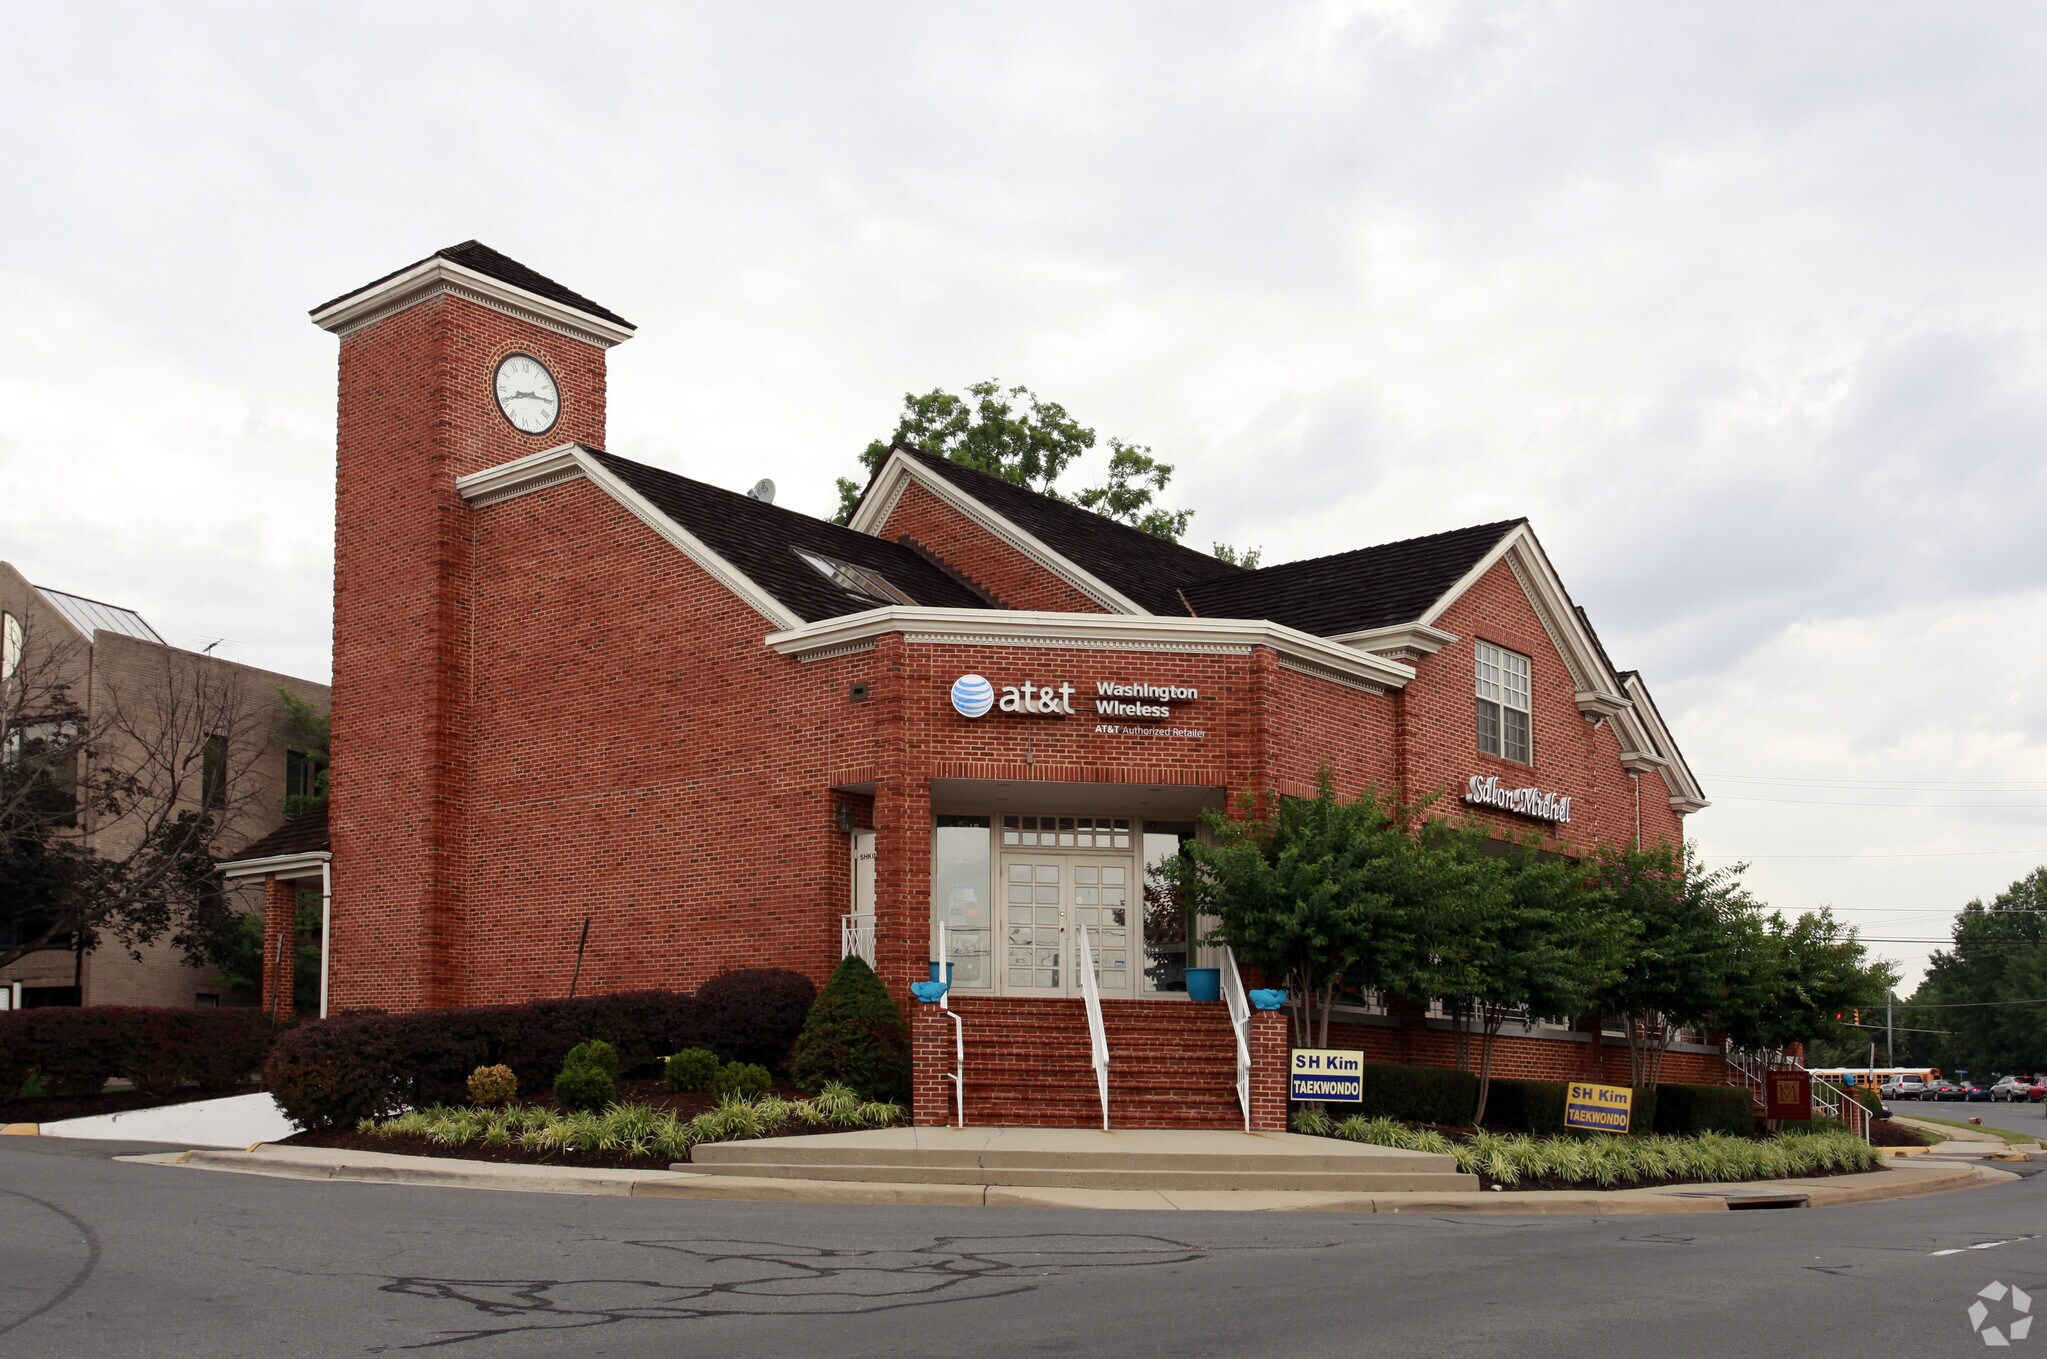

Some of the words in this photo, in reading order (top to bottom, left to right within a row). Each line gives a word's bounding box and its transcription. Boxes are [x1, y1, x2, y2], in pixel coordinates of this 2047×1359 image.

[999, 680, 1075, 714] at&t
[1096, 681, 1198, 701] Washington
[1096, 700, 1170, 718] Wireless
[1095, 725, 1120, 734] AT&T
[1122, 726, 1170, 736] Authorized
[1172, 728, 1206, 738] Retailer
[1468, 775, 1515, 810] Salon
[1519, 788, 1571, 823] Michel
[1326, 1056, 1358, 1070] Kim
[1294, 1080, 1359, 1095] TAEKWONDO
[1598, 1089, 1628, 1104] Kim
[1569, 1109, 1627, 1126] TAEKWONDO
